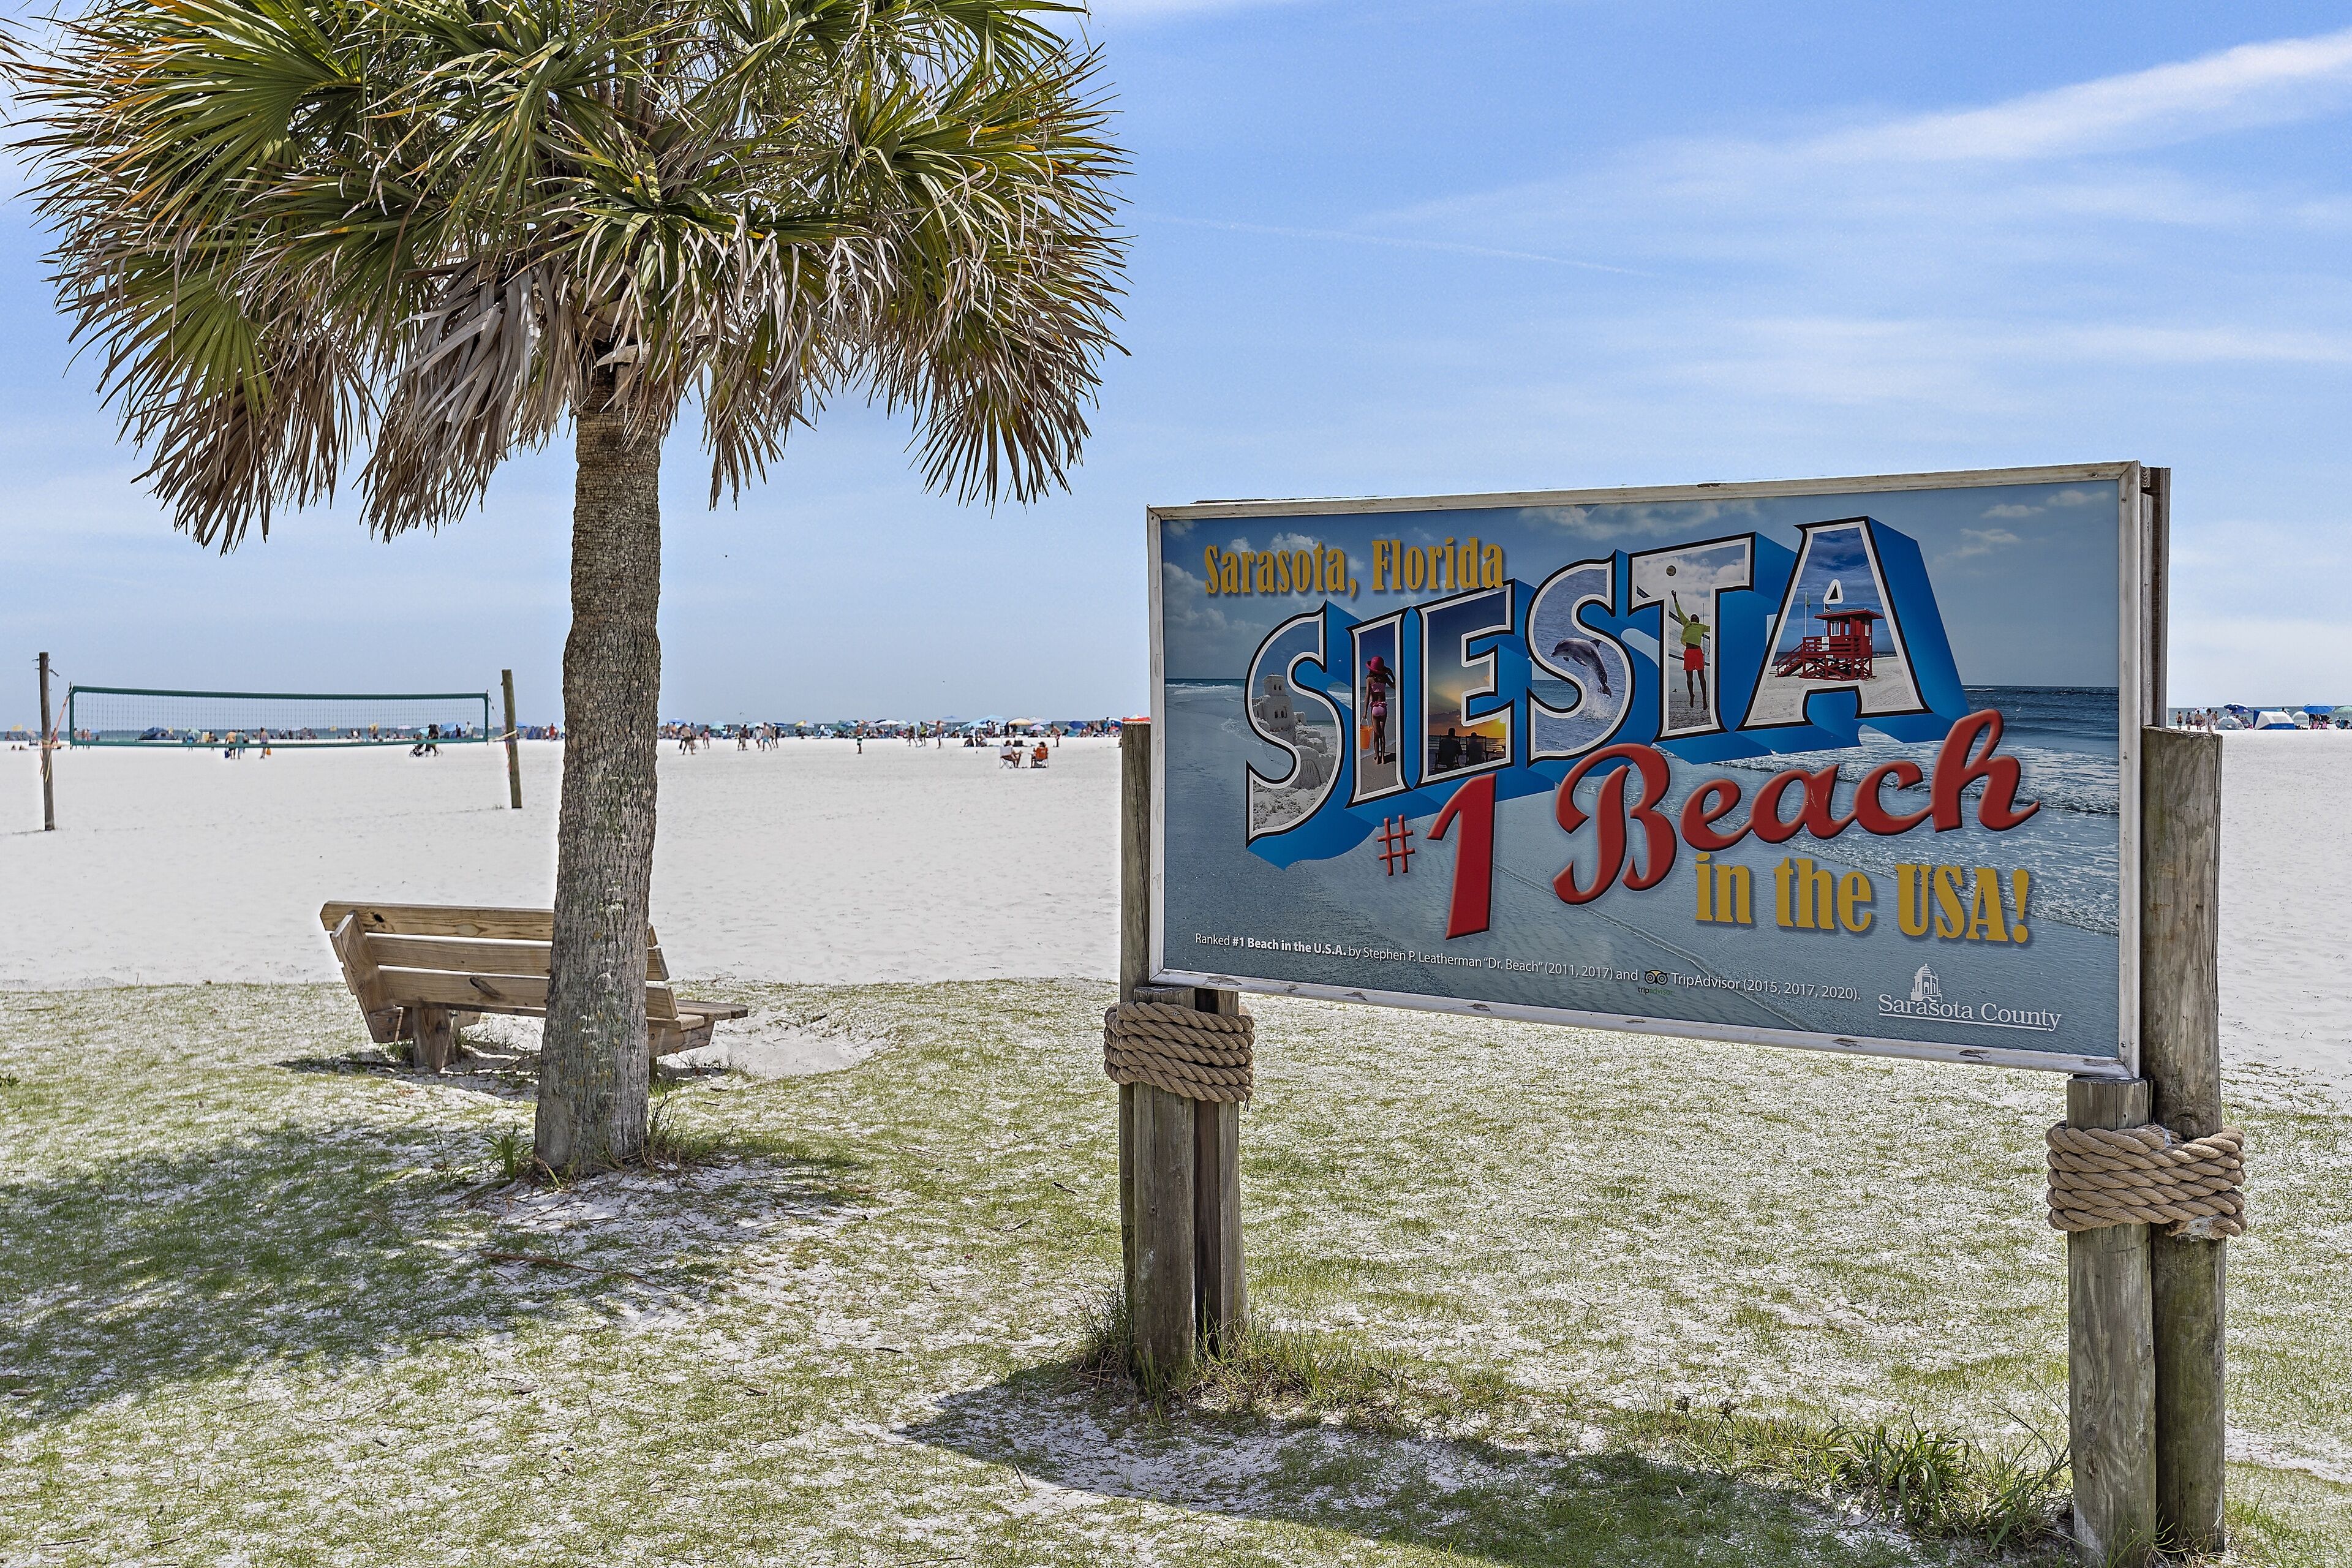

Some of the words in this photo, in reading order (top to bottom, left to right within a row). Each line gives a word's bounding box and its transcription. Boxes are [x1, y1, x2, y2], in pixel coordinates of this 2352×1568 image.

[1204, 541, 1357, 598] Sarasota,
[1371, 537, 1504, 590] Florida
[1245, 516, 1932, 851] SIESTA
[1377, 772, 1496, 940] #1
[1553, 709, 2040, 905] Beach
[1695, 852, 1752, 924] in
[1774, 856, 1872, 932] the
[1894, 862, 2030, 944] USA!
[1196, 933, 1230, 946] Ranked
[1232, 937, 1244, 947] #1
[1247, 937, 1279, 950] Beach
[1281, 940, 1291, 951] in
[1293, 941, 1311, 953] the
[1314, 943, 1347, 956] U.S.A.
[1349, 945, 1361, 960] by
[1363, 947, 1406, 962] Stephen
[1409, 951, 1416, 962] P.
[1419, 952, 1482, 967] Leatherman
[1545, 962, 1578, 978] (2011,
[1581, 965, 1613, 980] 2017)
[1616, 969, 1638, 981] and
[1671, 972, 1741, 990] TripAdvisor
[1743, 978, 1781, 995] (2015,
[1784, 982, 1819, 998] 2017,
[1822, 985, 1861, 1001] 2020).
[1638, 986, 1674, 996] tripadvisor
[1878, 993, 1975, 1020] Sarasota
[1980, 1002, 2062, 1032] County
